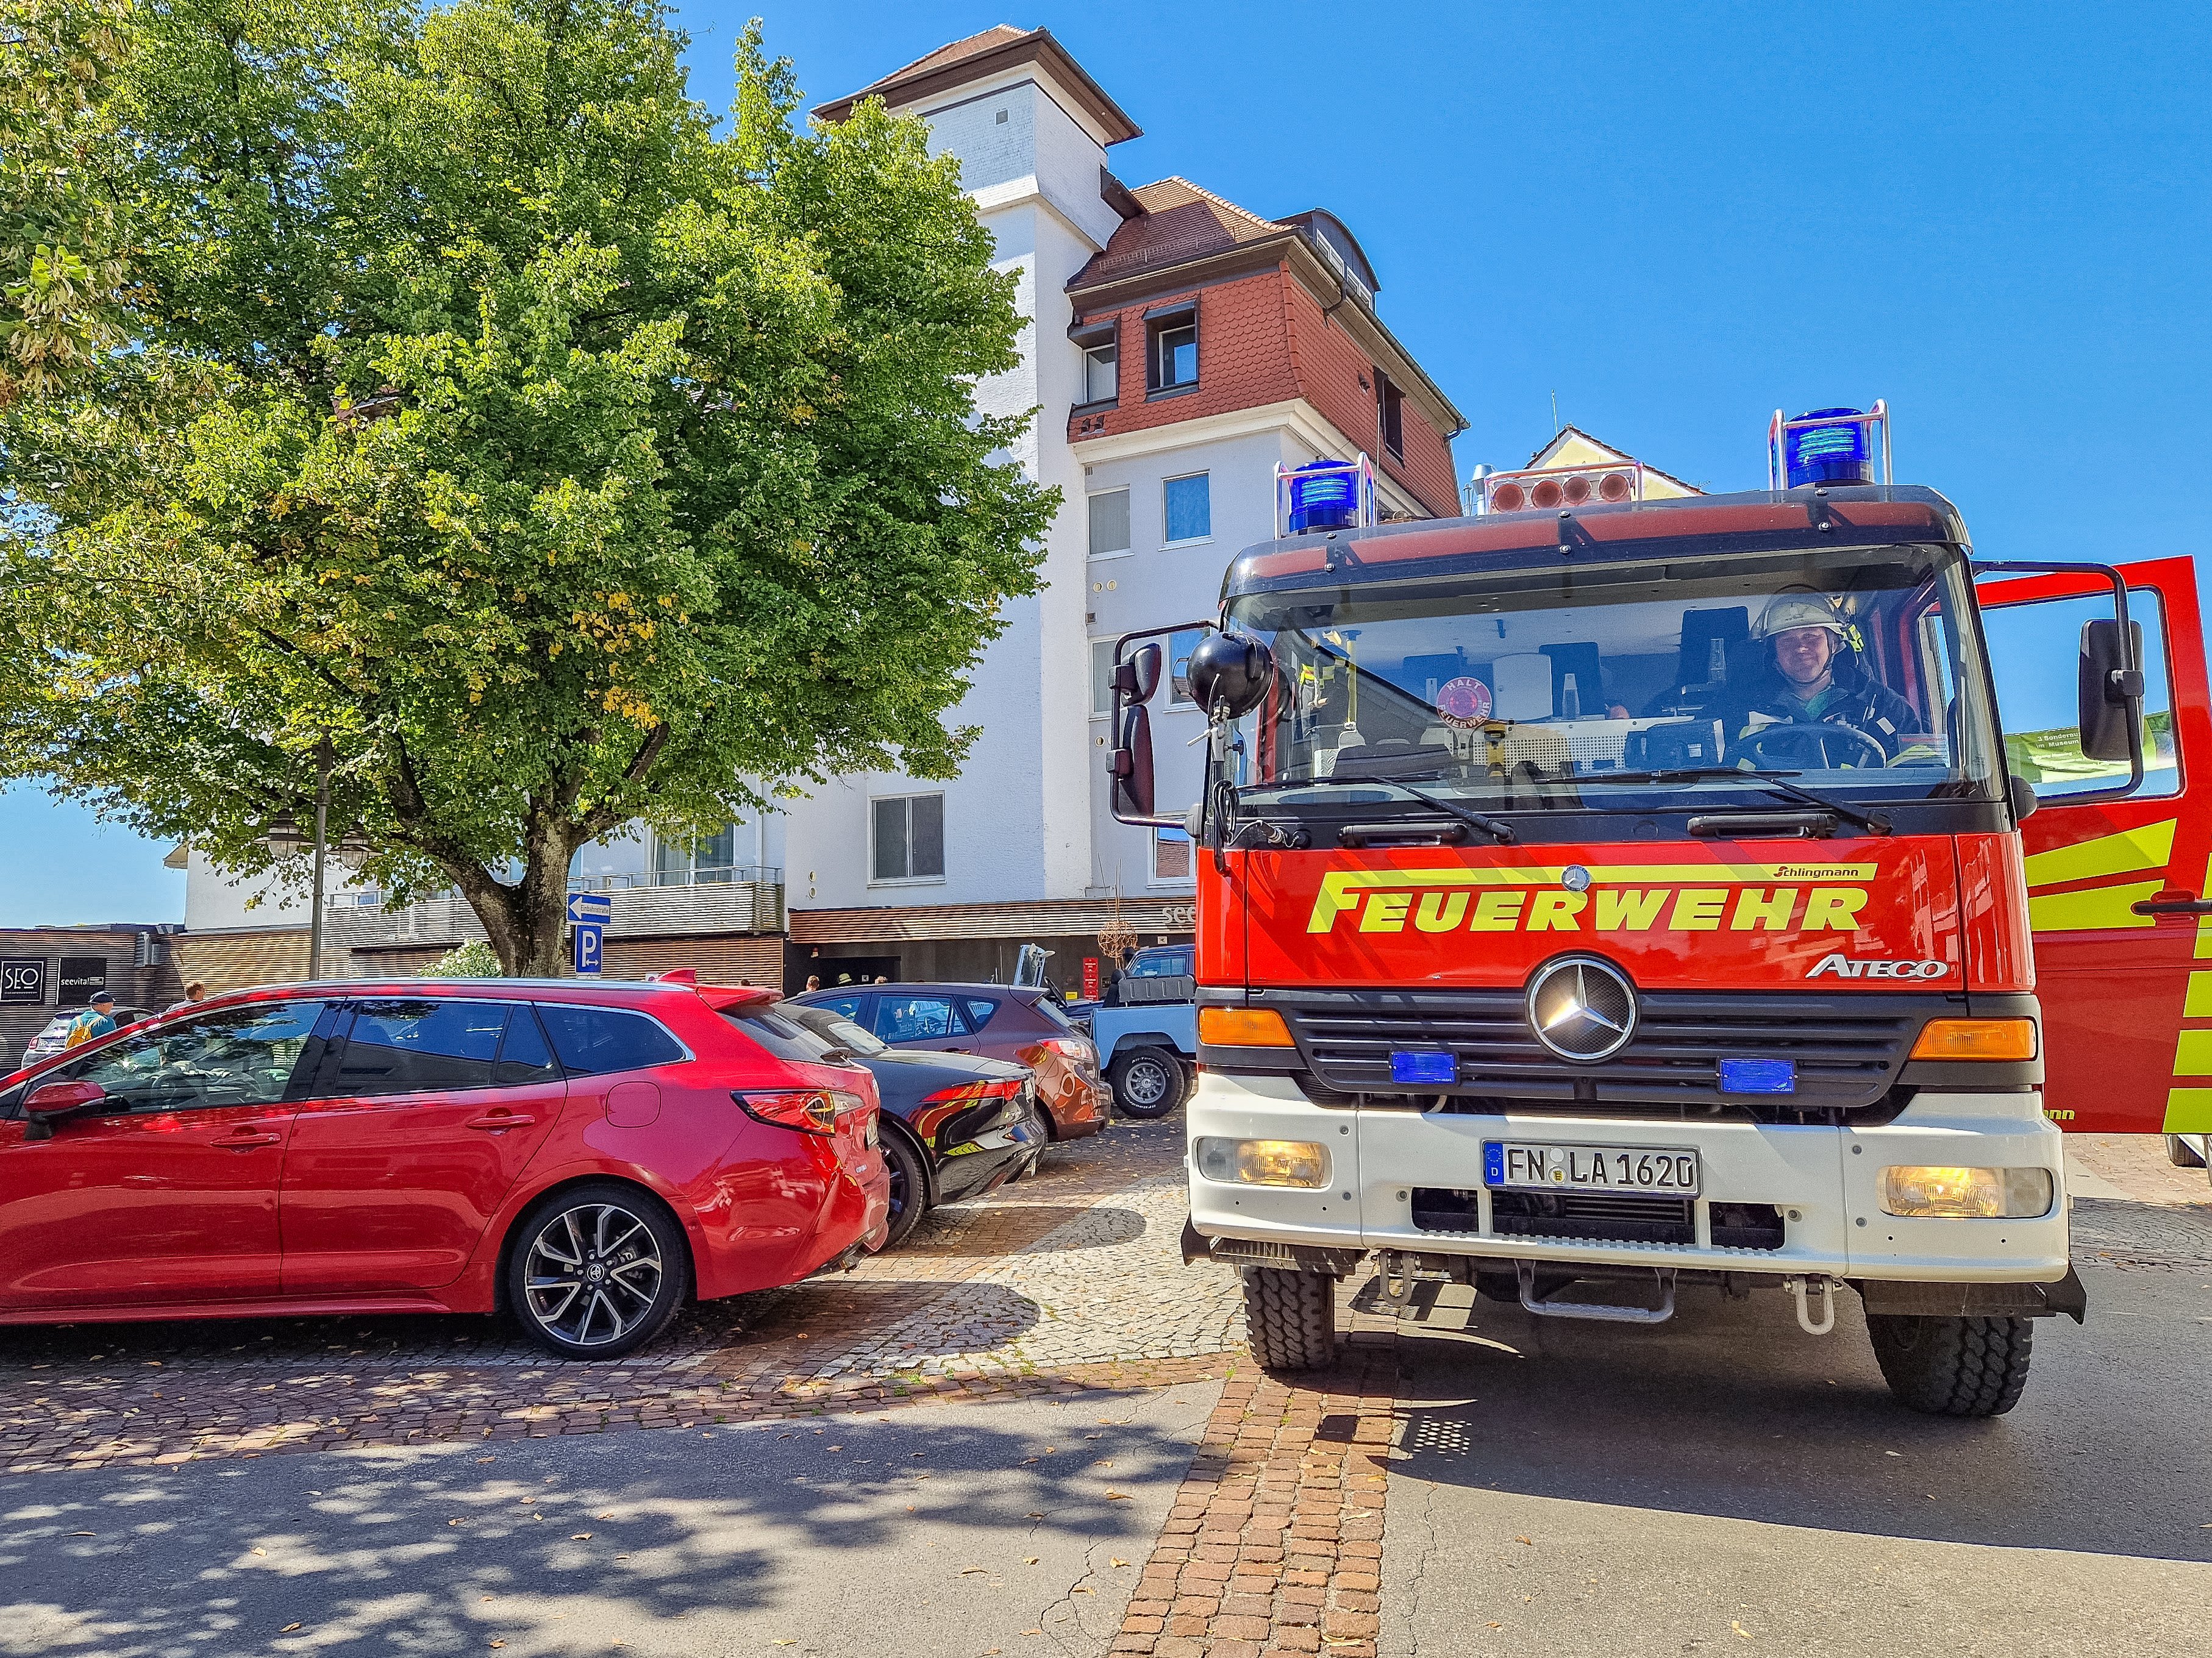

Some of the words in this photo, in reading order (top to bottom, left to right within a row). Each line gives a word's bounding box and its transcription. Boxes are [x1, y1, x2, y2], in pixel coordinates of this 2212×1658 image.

[1446, 679, 1482, 691] HALT
[1438, 702, 1490, 728] FEUERWEHR
[1773, 866, 1859, 878] Schlingmann
[1307, 863, 1878, 933] FEUERWEHR
[580, 905, 609, 914] Einbahnstraße
[1162, 906, 1196, 923] see
[582, 930, 597, 967] P
[1805, 953, 1950, 978] ATEGO
[5, 968, 38, 989] SEO
[60, 977, 90, 986] seevital
[1491, 1167, 1499, 1176] D
[1507, 1149, 1546, 1181] FN
[1569, 1151, 1608, 1184] LA
[1616, 1153, 1694, 1187] 1620
